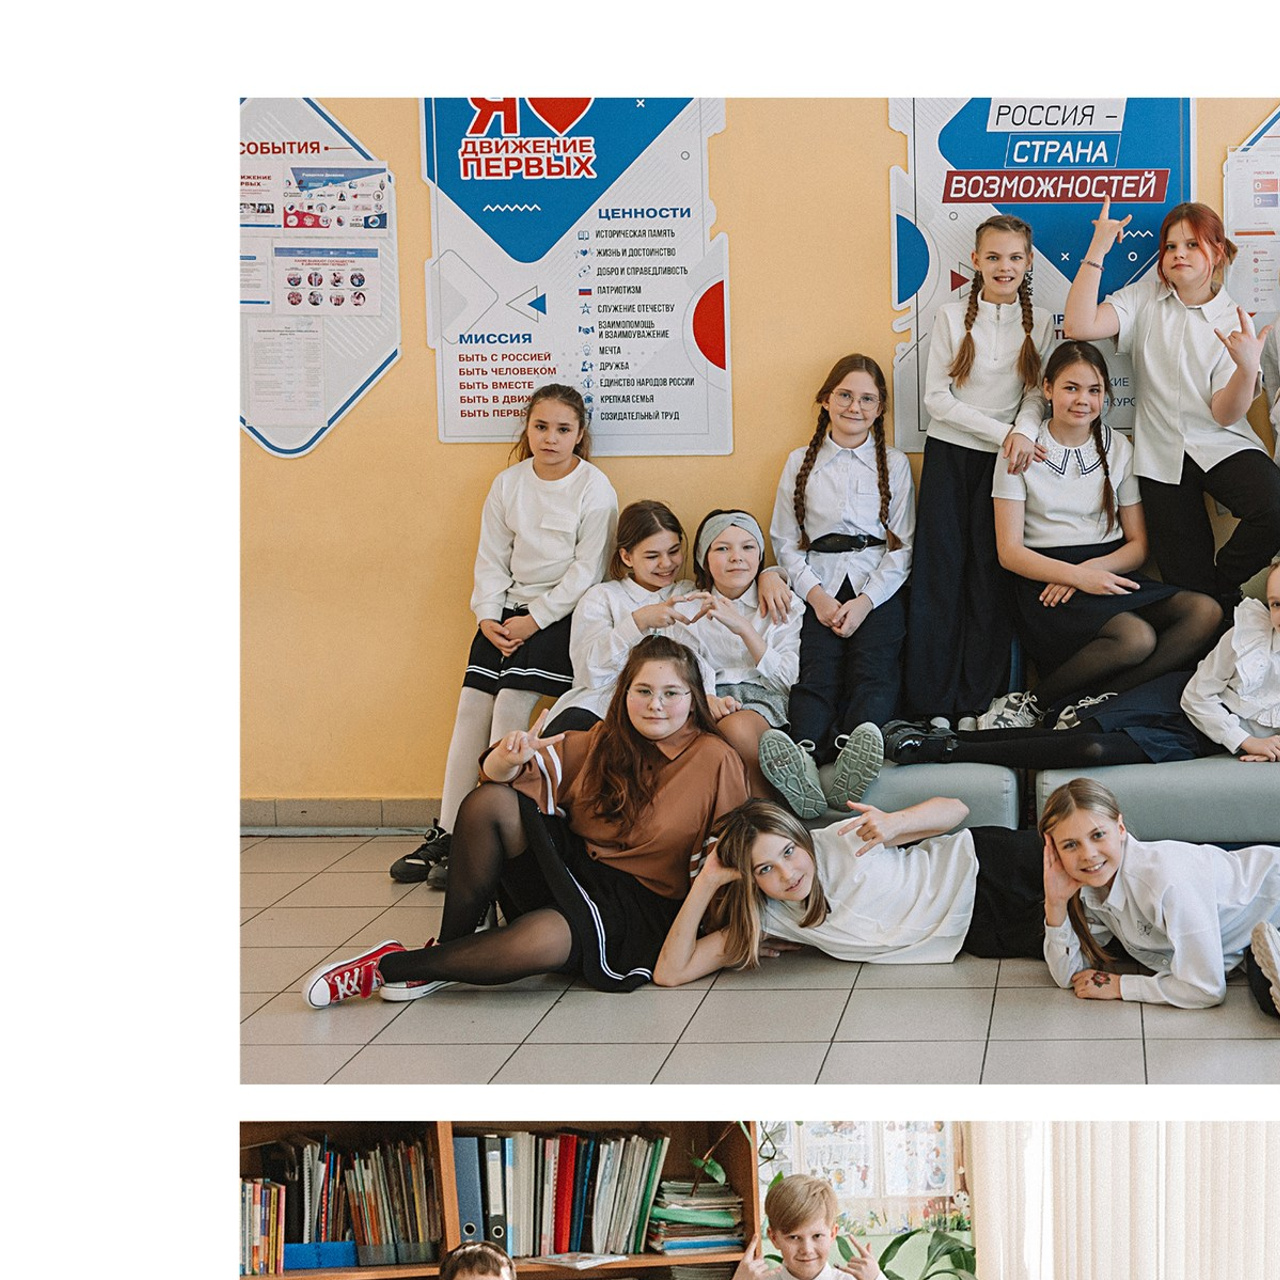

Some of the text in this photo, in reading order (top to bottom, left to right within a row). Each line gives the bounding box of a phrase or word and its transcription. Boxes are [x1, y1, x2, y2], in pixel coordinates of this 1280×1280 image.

[995, 105, 1095, 126] РОССИЯ
[461, 139, 593, 157] ДВИЖЕНИЕ
[1013, 141, 1108, 164] СТРАНА
[461, 156, 596, 178] ПЕРВЫХ
[949, 171, 1157, 198] ВОЗМОЖНОСТЕЙ
[598, 207, 691, 221] ЦЕННОСТИ
[595, 229, 676, 239] ИСТОРИЧЕСКАЯ ПАМЯТЬ
[596, 247, 676, 258] ЖИЗНЬ И ДОСТОИНСТВО
[596, 266, 688, 277] ДОБРО И СПРАВЕДЛИВОСТЬ
[597, 285, 642, 295] ПАТРИОТИЗМ
[597, 303, 675, 313] СЛУЖЕНИЕ ОТЕЧЕСТВУ
[598, 320, 655, 329] ВЗАИМОПОМОЩЬ
[459, 333, 532, 344] МИССИЯ
[598, 329, 670, 339] И ВЗАИМОУВАЖЕНИЕ
[599, 346, 621, 355] МЕЧТА
[458, 351, 551, 362] БЫТЬ С РОССИЕЙ
[459, 367, 557, 376] БЫТЬ ЧЕЛОВЕКОМ
[599, 362, 630, 371] ДРУЖБА
[459, 381, 534, 390] БЫТЬ ВМЕСТЕ
[600, 377, 695, 388] ЕДИНСТВО НАРОДОВ РОССИИ
[460, 395, 489, 404] БЫТЬ
[492, 395, 499, 403] В
[600, 394, 655, 403] КРЕПКАЯ СЕМЬЯ
[460, 409, 489, 418] БЫТЬ
[600, 410, 680, 421] СОЗИДАТЕЛЬНЫЙ ТРУД
